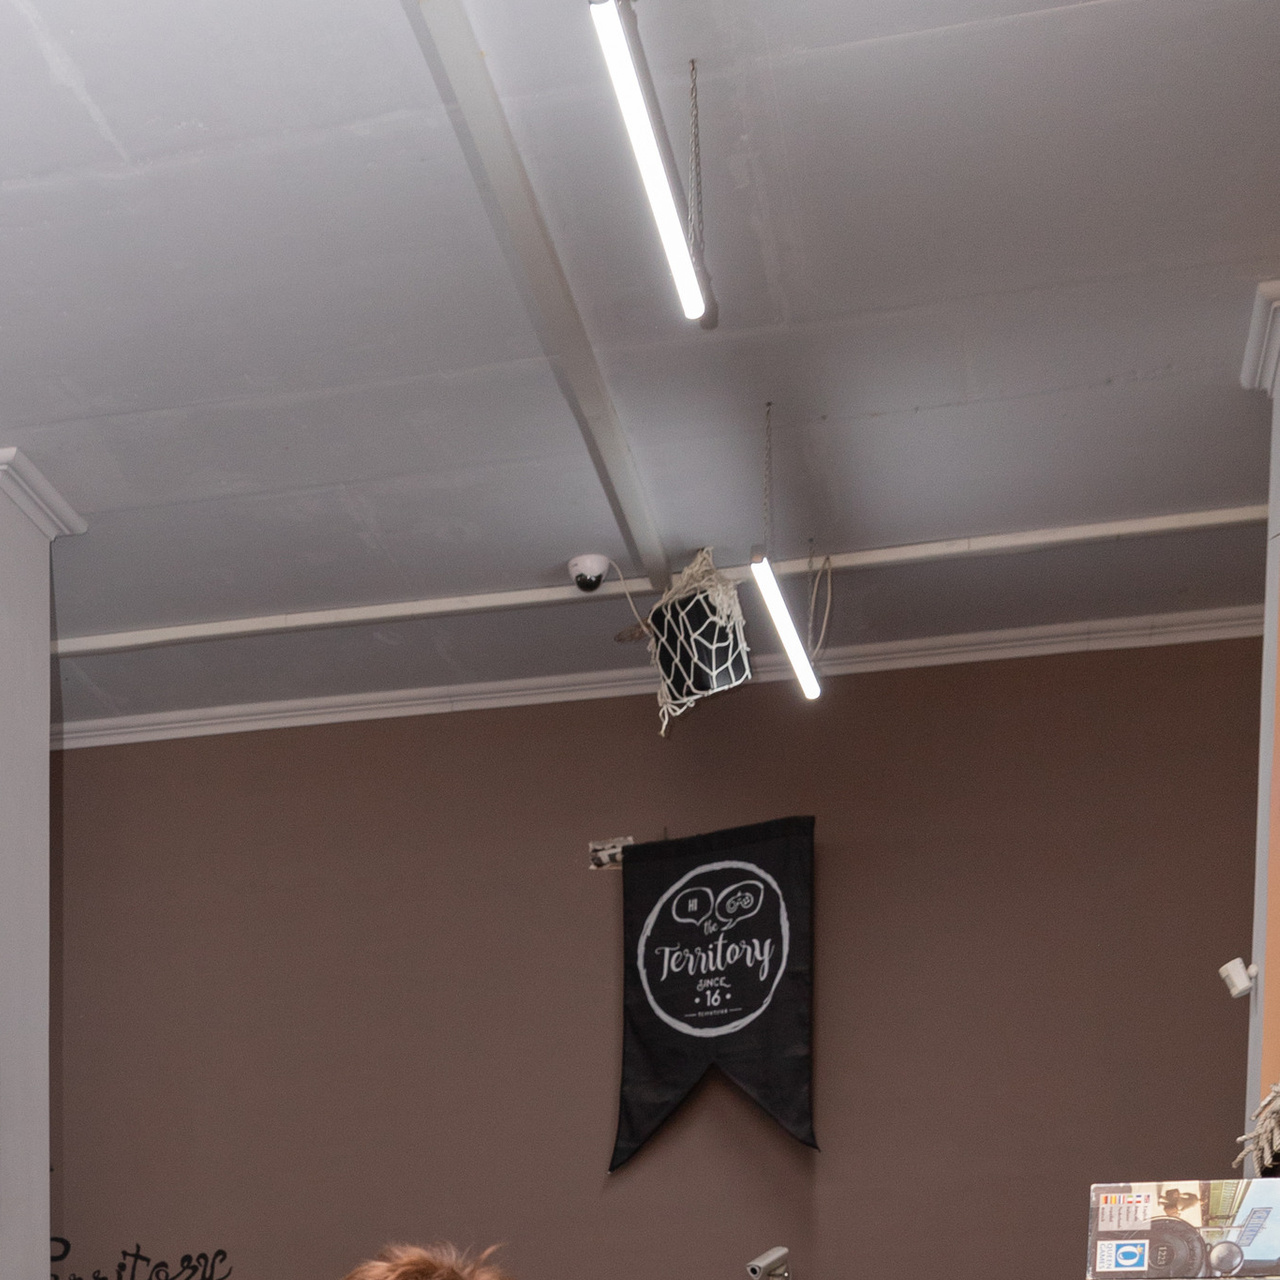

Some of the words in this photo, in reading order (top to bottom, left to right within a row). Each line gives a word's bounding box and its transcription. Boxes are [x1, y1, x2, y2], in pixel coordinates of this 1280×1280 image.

[687, 897, 698, 913] HI
[703, 920, 719, 936] the
[654, 933, 775, 982] Territory
[696, 976, 732, 992] SINCE
